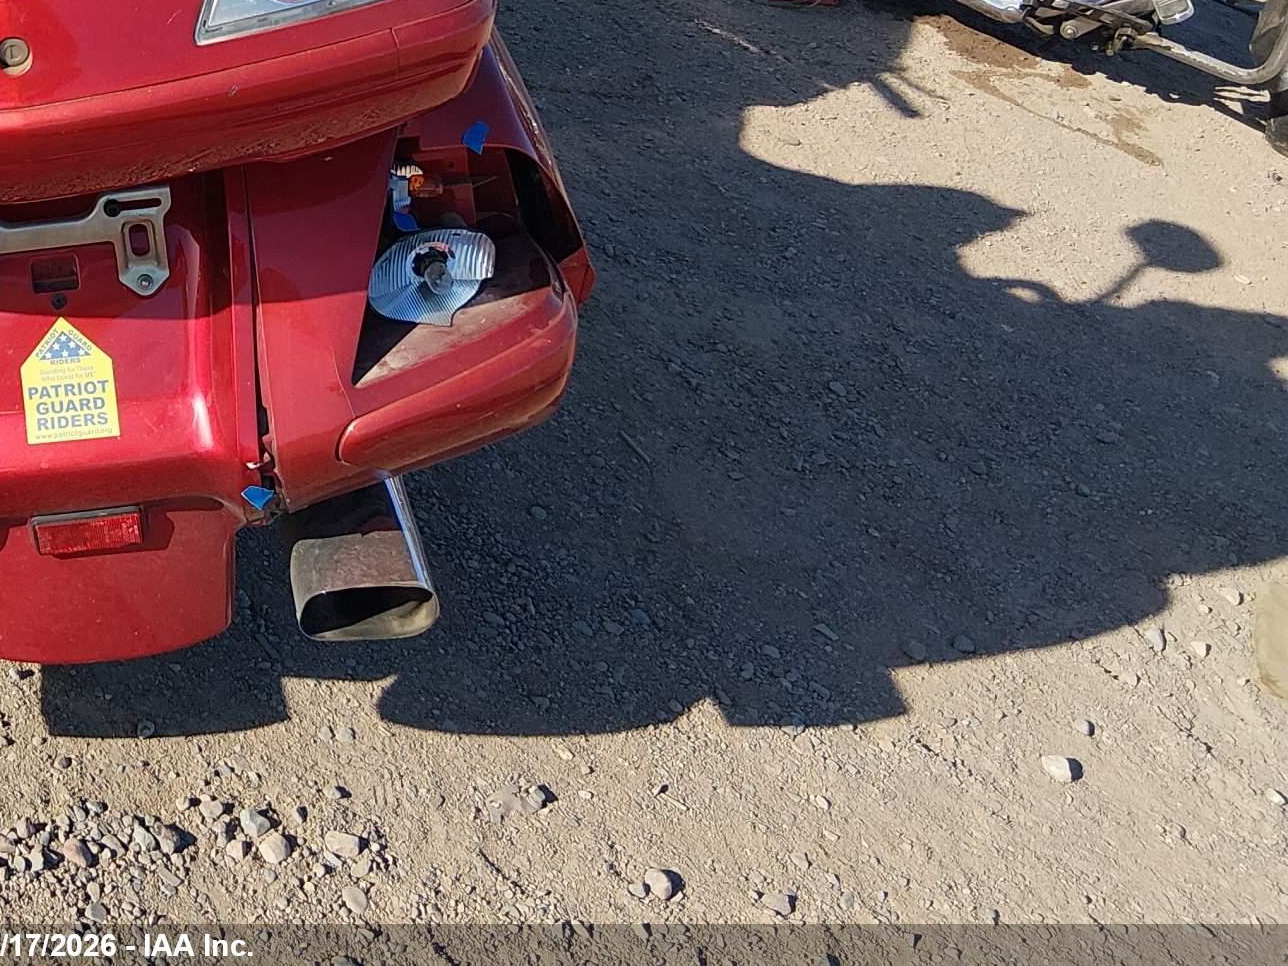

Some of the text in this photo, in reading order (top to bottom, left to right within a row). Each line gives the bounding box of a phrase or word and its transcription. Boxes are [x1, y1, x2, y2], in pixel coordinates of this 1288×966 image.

[35, 328, 93, 358] PATRIOT GUARD
[50, 357, 81, 366] RIDERS
[28, 380, 108, 400] PATRIOT
[36, 397, 105, 415] GUARD
[37, 412, 108, 431] RIDERS
